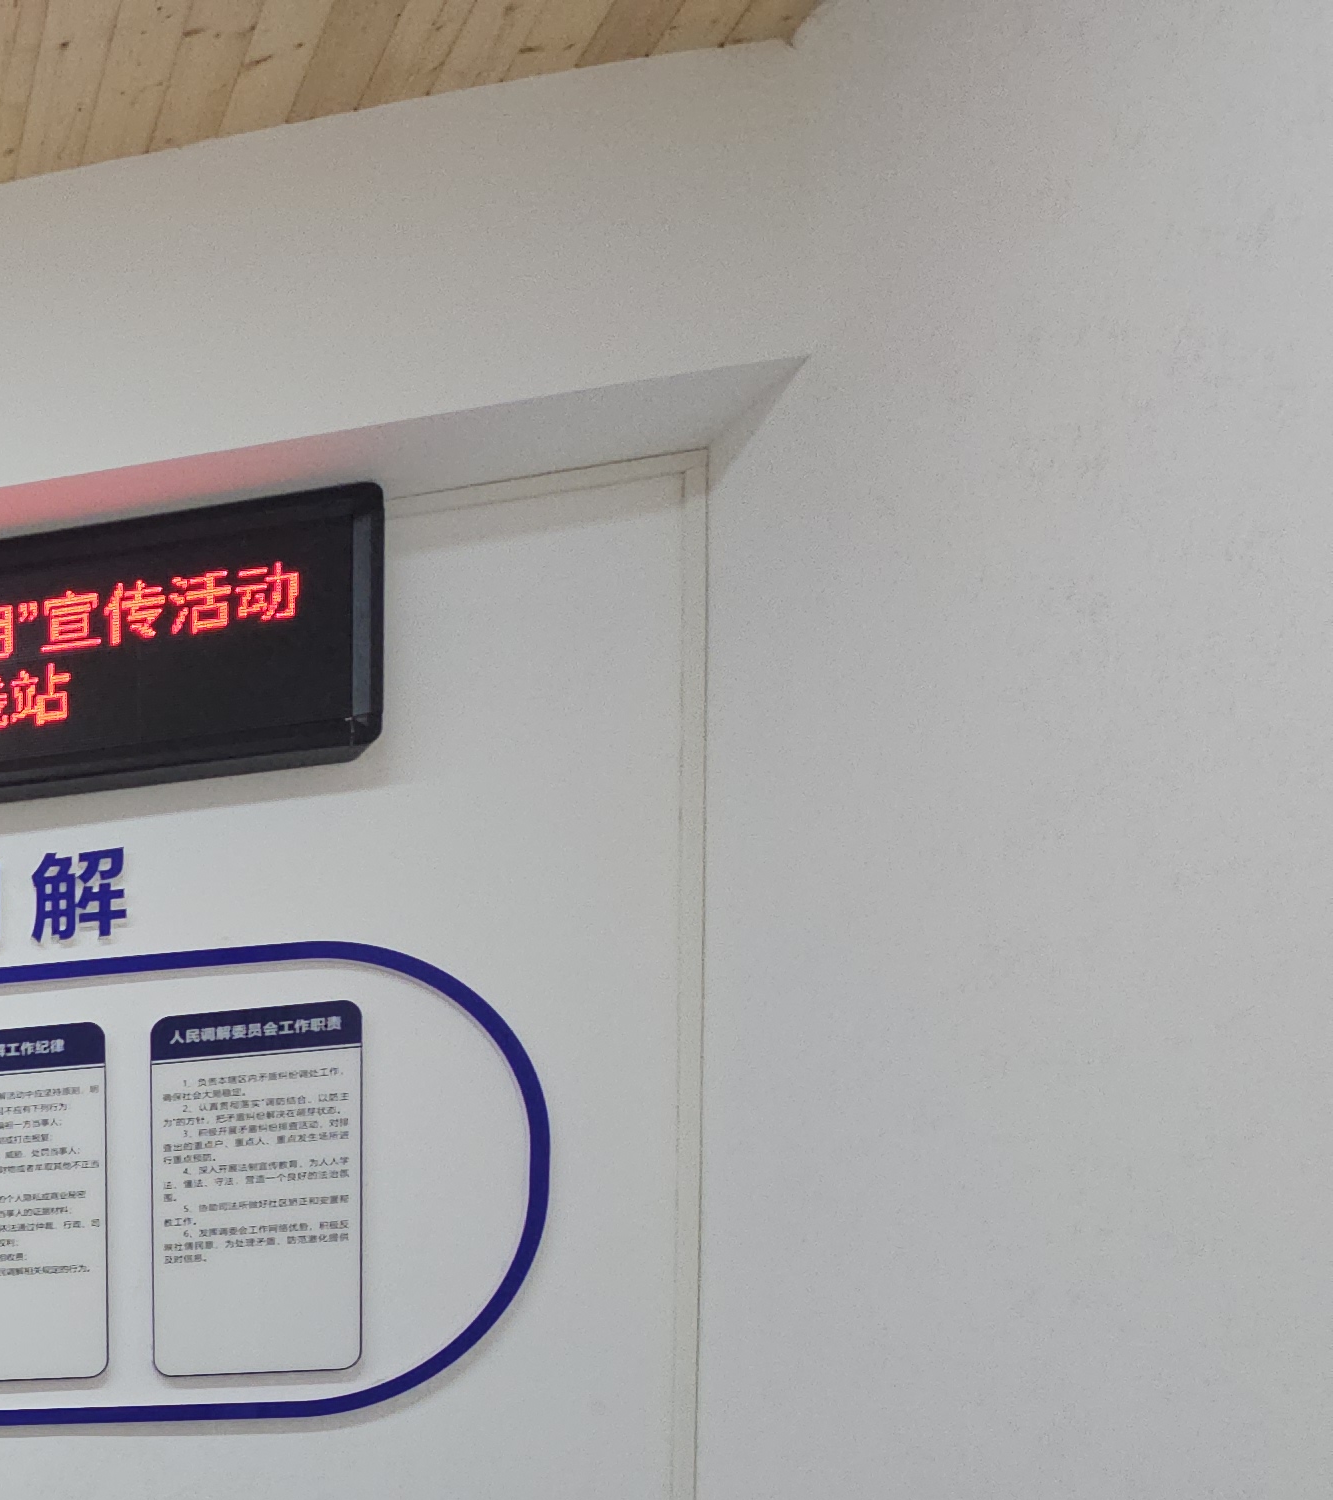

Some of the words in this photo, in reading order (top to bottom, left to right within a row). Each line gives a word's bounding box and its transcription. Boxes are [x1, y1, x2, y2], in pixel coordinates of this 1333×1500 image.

[169, 1016, 342, 1044] 人民调解委员会工作职责
